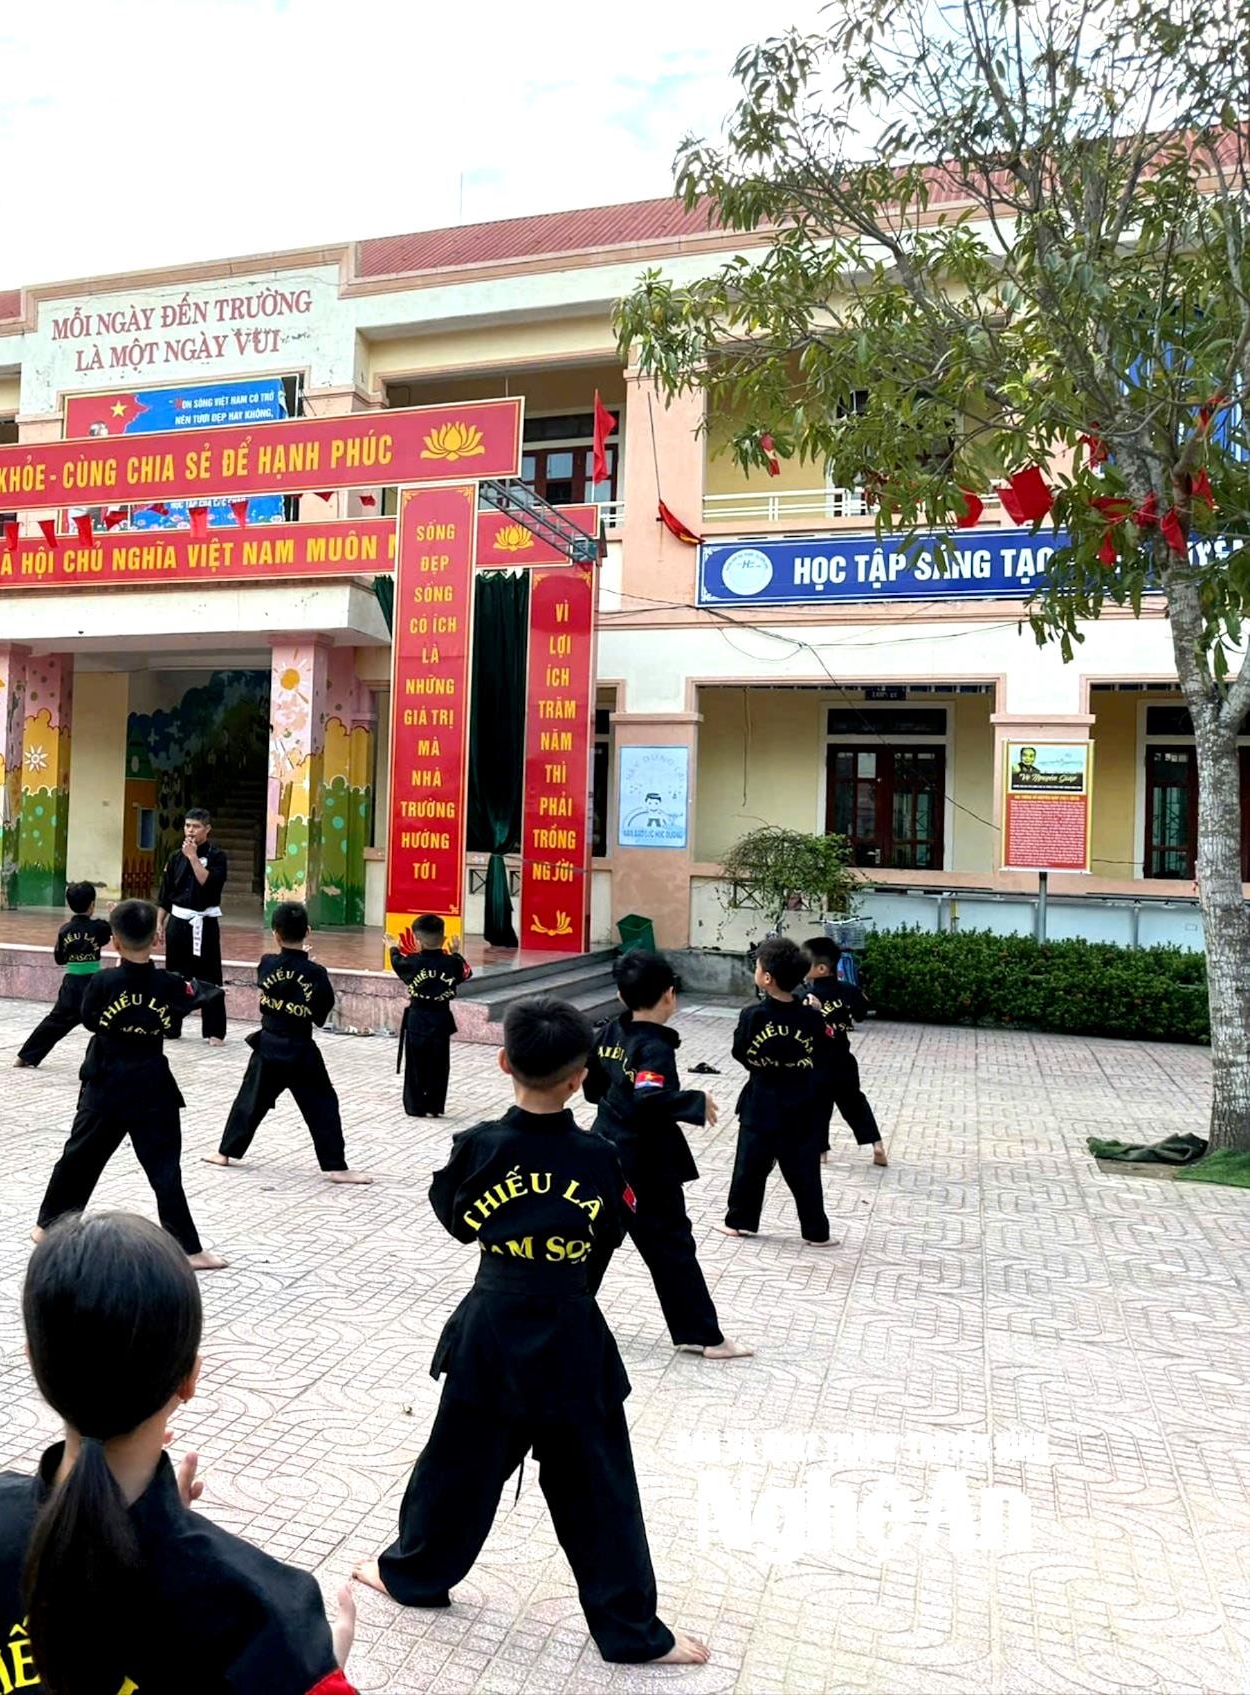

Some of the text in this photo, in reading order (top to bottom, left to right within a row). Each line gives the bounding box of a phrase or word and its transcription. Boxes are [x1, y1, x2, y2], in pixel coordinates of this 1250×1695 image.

[52, 288, 313, 340] MỖI NGÀY ĐẾN TRƯỜNG
[76, 328, 281, 372] LÀ MỘT NGÀY VUI
[230, 396, 247, 406] NAM
[228, 411, 243, 421] HAY
[63, 453, 117, 489] CÙNG
[126, 454, 174, 485] CHIA
[185, 442, 211, 480] SẺ
[222, 436, 252, 477] ĐỂ
[258, 441, 319, 479] HẠNH
[331, 429, 393, 469] PHÚC
[416, 519, 456, 542] SỐNG
[21, 548, 54, 579] HỘI
[62, 541, 103, 572] CHỦ
[112, 540, 177, 571] NGHĨA
[187, 537, 234, 573] VIỆT
[242, 539, 295, 565] NAM
[307, 530, 377, 562] MUÔN
[420, 555, 449, 576] ĐẸP
[793, 556, 847, 591] HỌC
[854, 545, 905, 590] TẬP
[414, 581, 453, 603] SỐNG
[555, 599, 569, 622] VÌ
[410, 613, 457, 634] CÓ ÍCH
[422, 643, 439, 664] LÀ
[550, 634, 571, 658] LỢI
[405, 674, 455, 695] NHỮNG
[546, 664, 570, 687] ÍCH
[404, 705, 454, 729] GIÁ TRỊ
[538, 696, 576, 719] TRĂM
[418, 736, 440, 757] MÀ
[540, 728, 572, 751] NĂM
[411, 766, 441, 787] NHÀ
[545, 761, 566, 784] THÌ
[401, 798, 455, 818] TRƯỜNG
[539, 792, 572, 816] PHẢI
[402, 829, 450, 849] HƯỚNG
[413, 859, 437, 880] TỚI
[99, 990, 143, 1029] THIẾU
[463, 1164, 552, 1231] THIẾU
